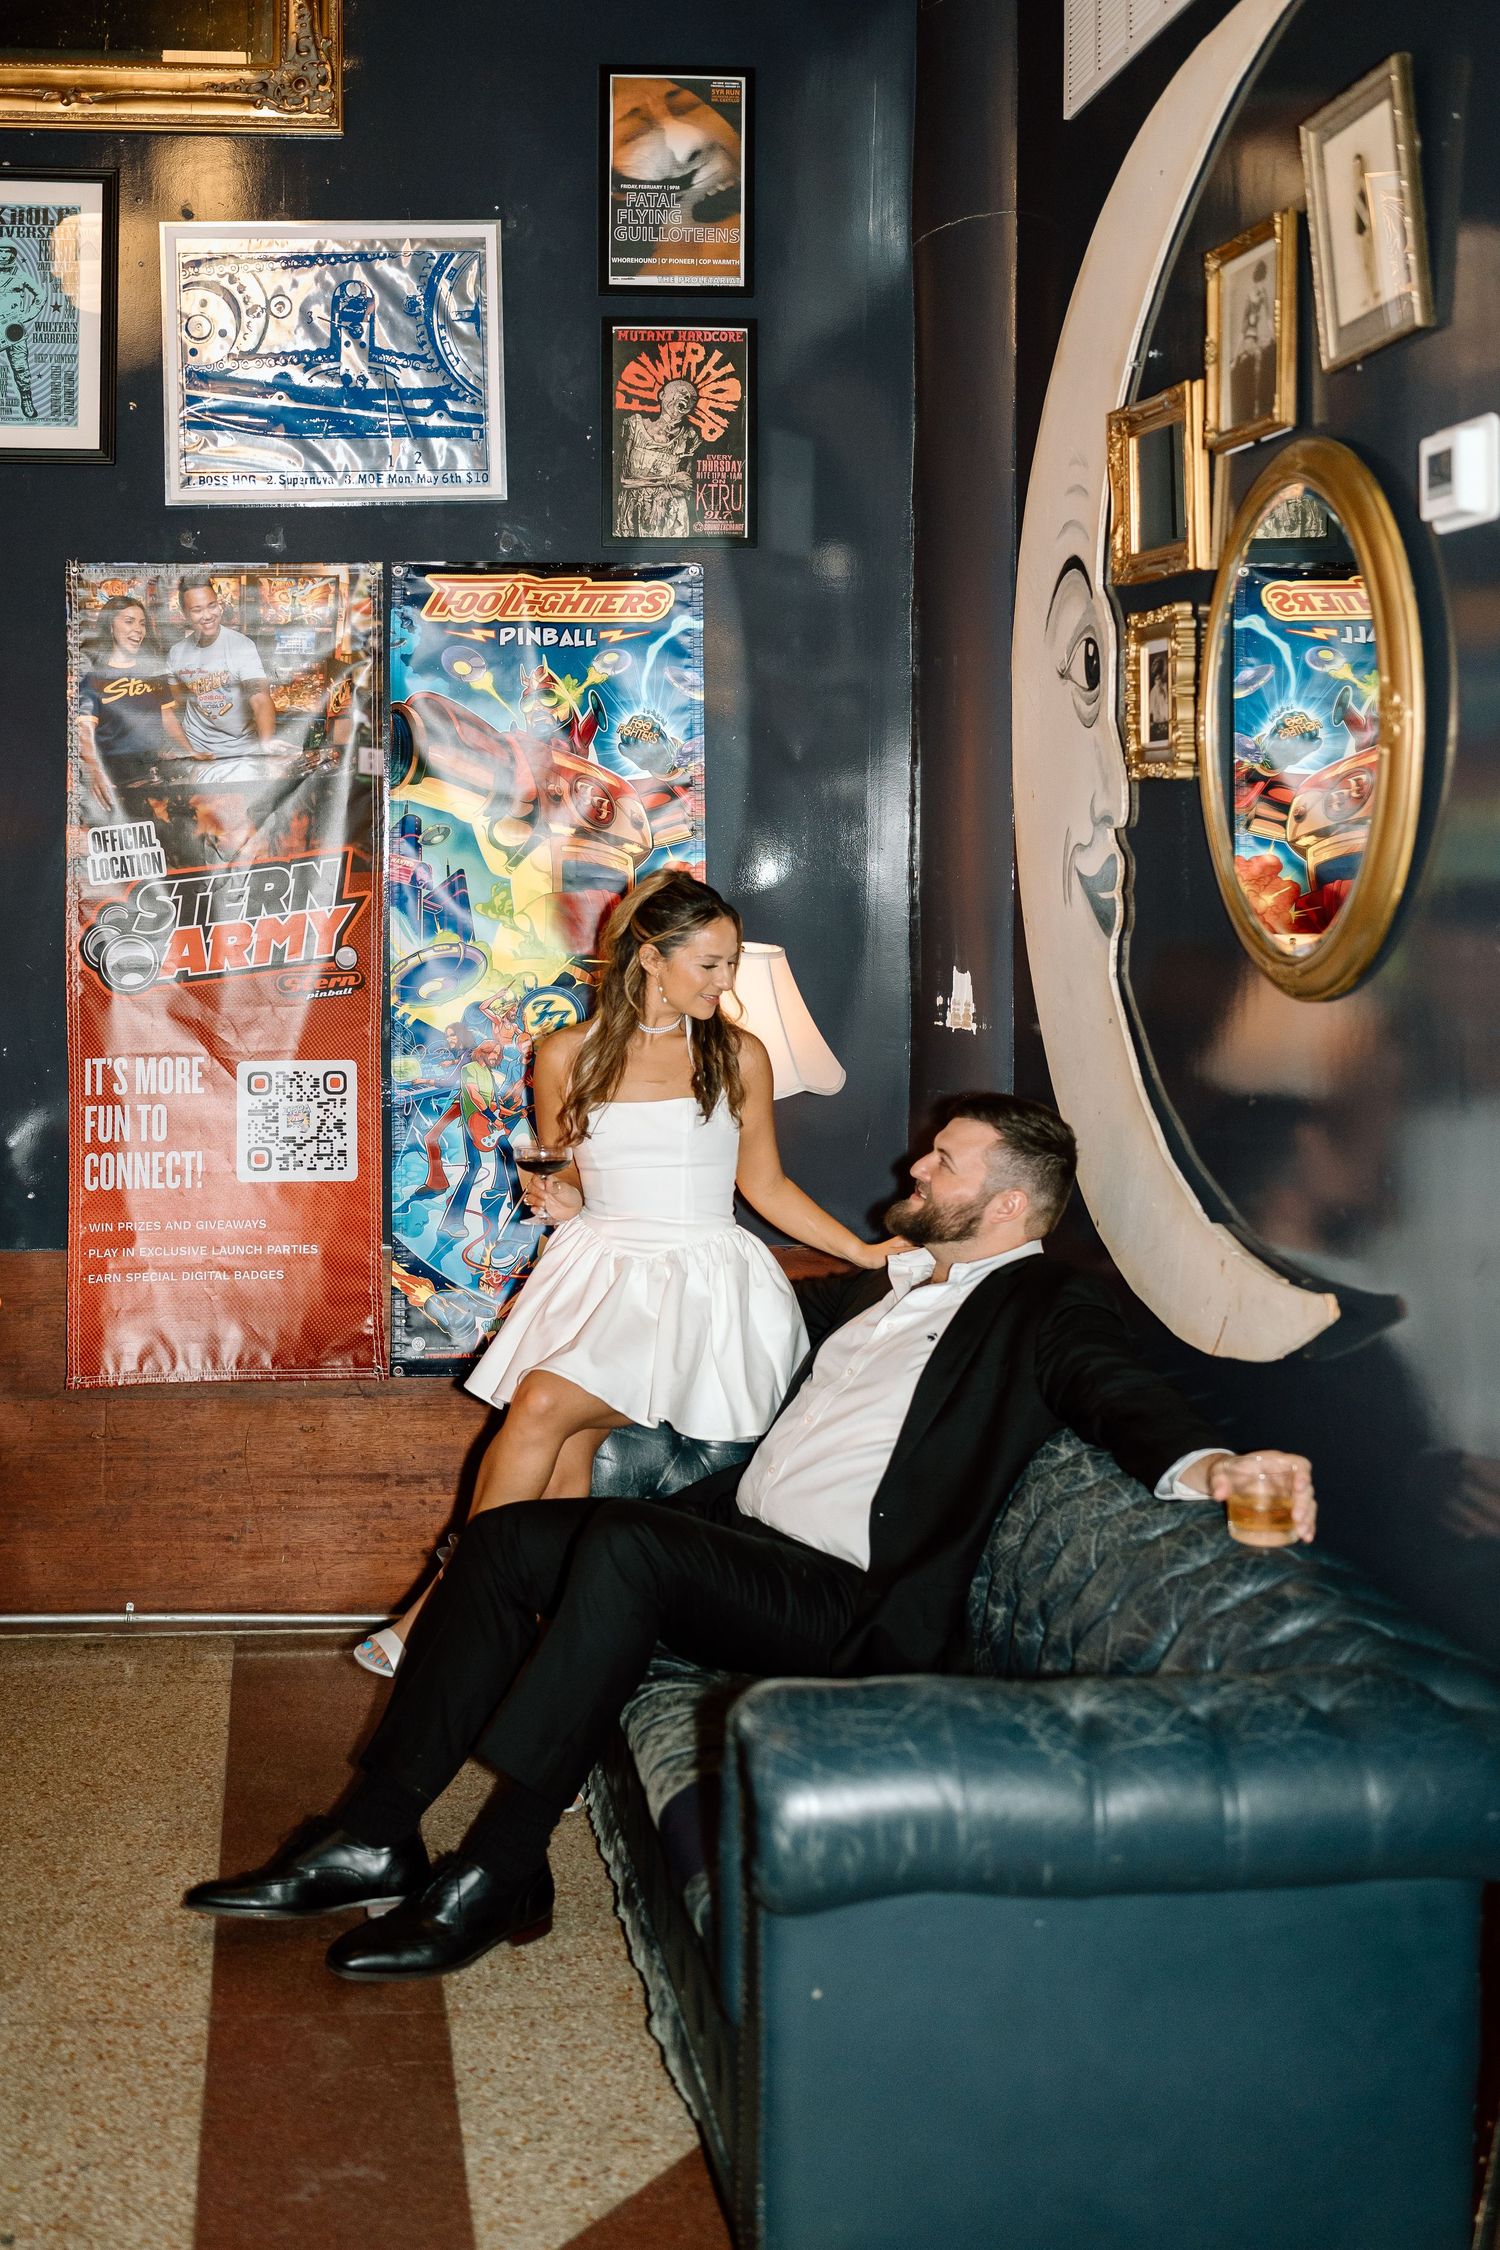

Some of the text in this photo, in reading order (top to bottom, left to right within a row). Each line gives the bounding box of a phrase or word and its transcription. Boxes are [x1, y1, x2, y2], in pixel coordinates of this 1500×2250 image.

[626, 191, 681, 208] FATAL
[617, 208, 682, 225] FLYING
[613, 226, 741, 243] GUILLOTEENS
[32, 333, 78, 344] BARBEQUE
[617, 331, 744, 342] MUTANT HARDCORE
[414, 451, 422, 464] 2
[696, 460, 743, 472] THURSDAY
[199, 475, 228, 486] BOSS
[358, 473, 384, 484] MOE
[388, 474, 414, 484] Mon.
[441, 473, 462, 484] 6th
[466, 472, 489, 485] $10
[695, 483, 743, 512] KTRU
[499, 626, 597, 647] PINBALL
[631, 718, 652, 731] FOO
[91, 825, 157, 855] OFFICIAL
[91, 851, 164, 882] LOCATION
[132, 857, 343, 934] STERN
[158, 903, 357, 980] ARMY
[306, 988, 353, 1000] pinball
[84, 1056, 205, 1096] IT'S MORE
[84, 1103, 168, 1144] FUN TO
[84, 1150, 203, 1192] CONNECT!
[89, 1219, 267, 1232] WIN PRIZES AND GIVEAWAYS
[88, 1244, 319, 1258] PLAY IN EXCLUSIVE LAUNCH PARTIES
[88, 1270, 285, 1284] EARN SPECIAL DIGITAL BADGES
